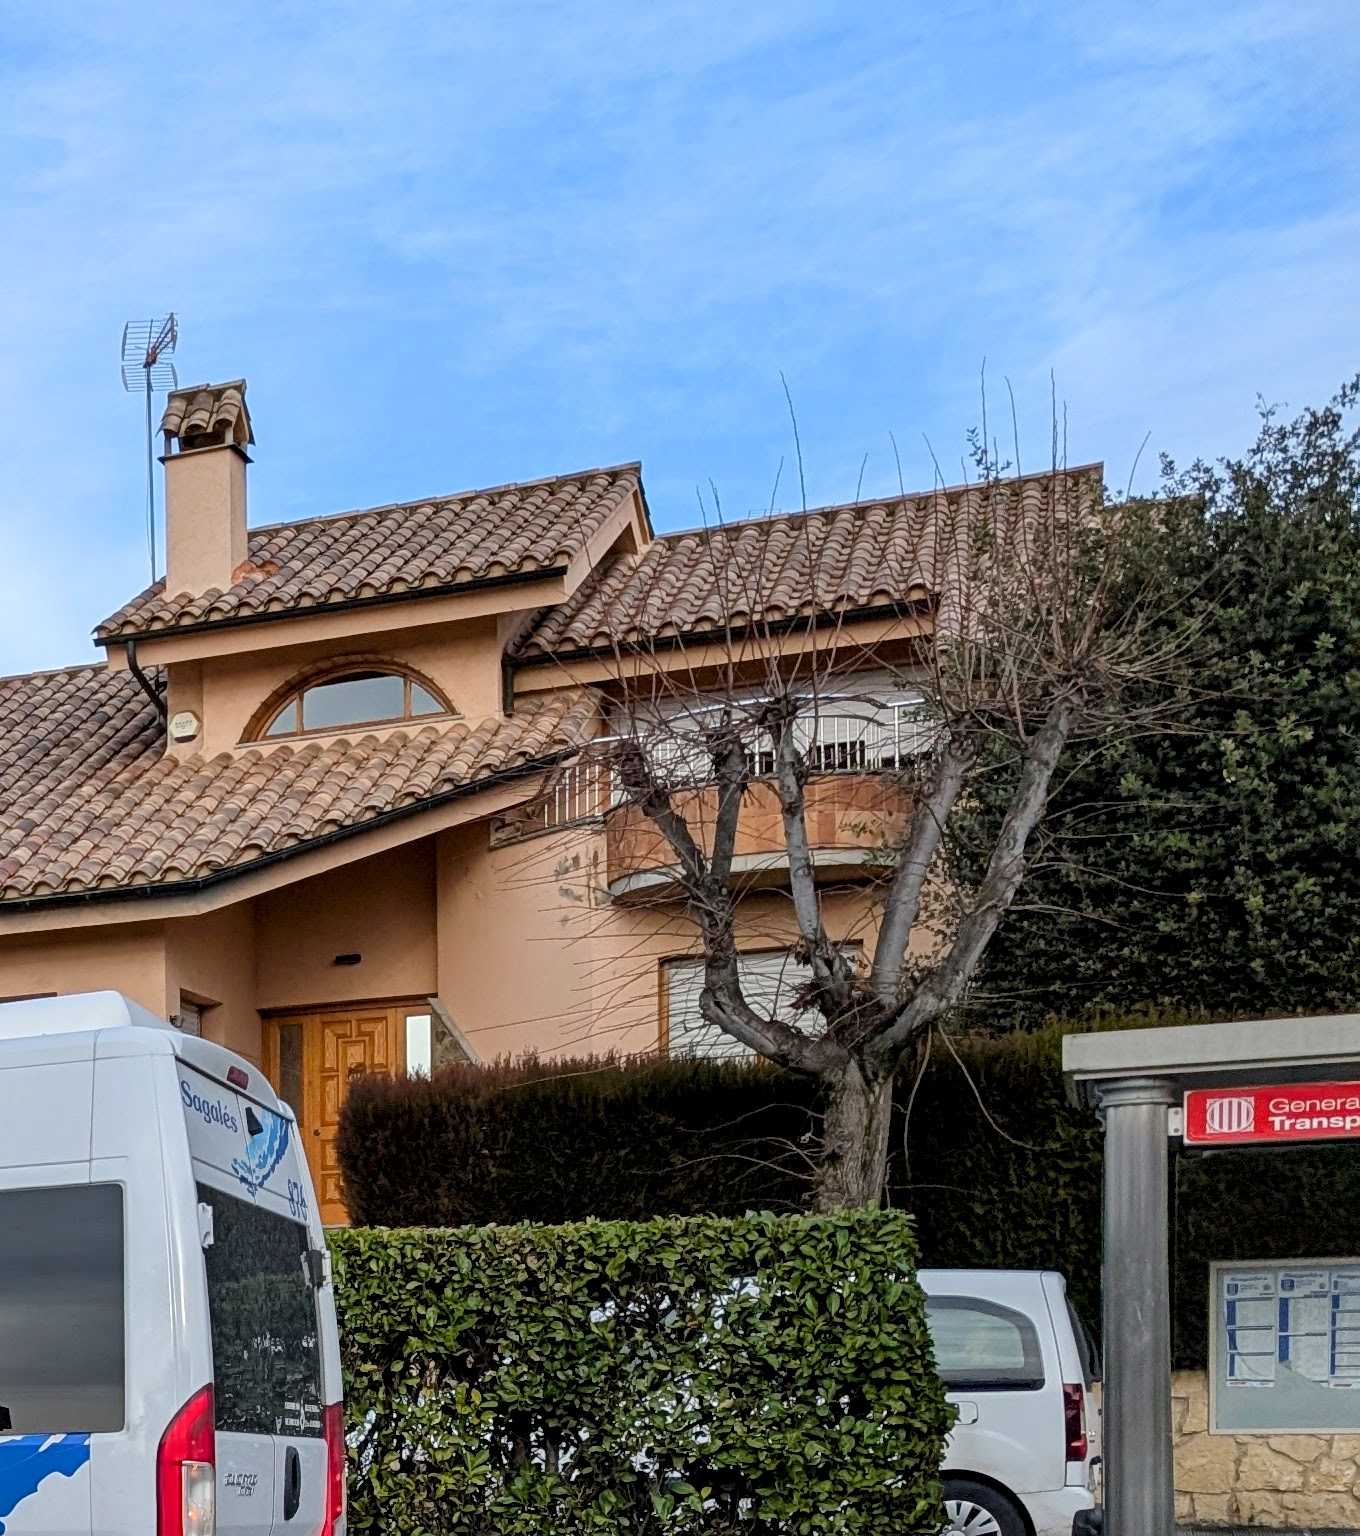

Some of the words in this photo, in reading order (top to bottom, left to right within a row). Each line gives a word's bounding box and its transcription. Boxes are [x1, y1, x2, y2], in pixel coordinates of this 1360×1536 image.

[181, 1080, 238, 1133] Sagalés
[1269, 1097, 1360, 1114] Genera
[1268, 1115, 1360, 1131] Transp
